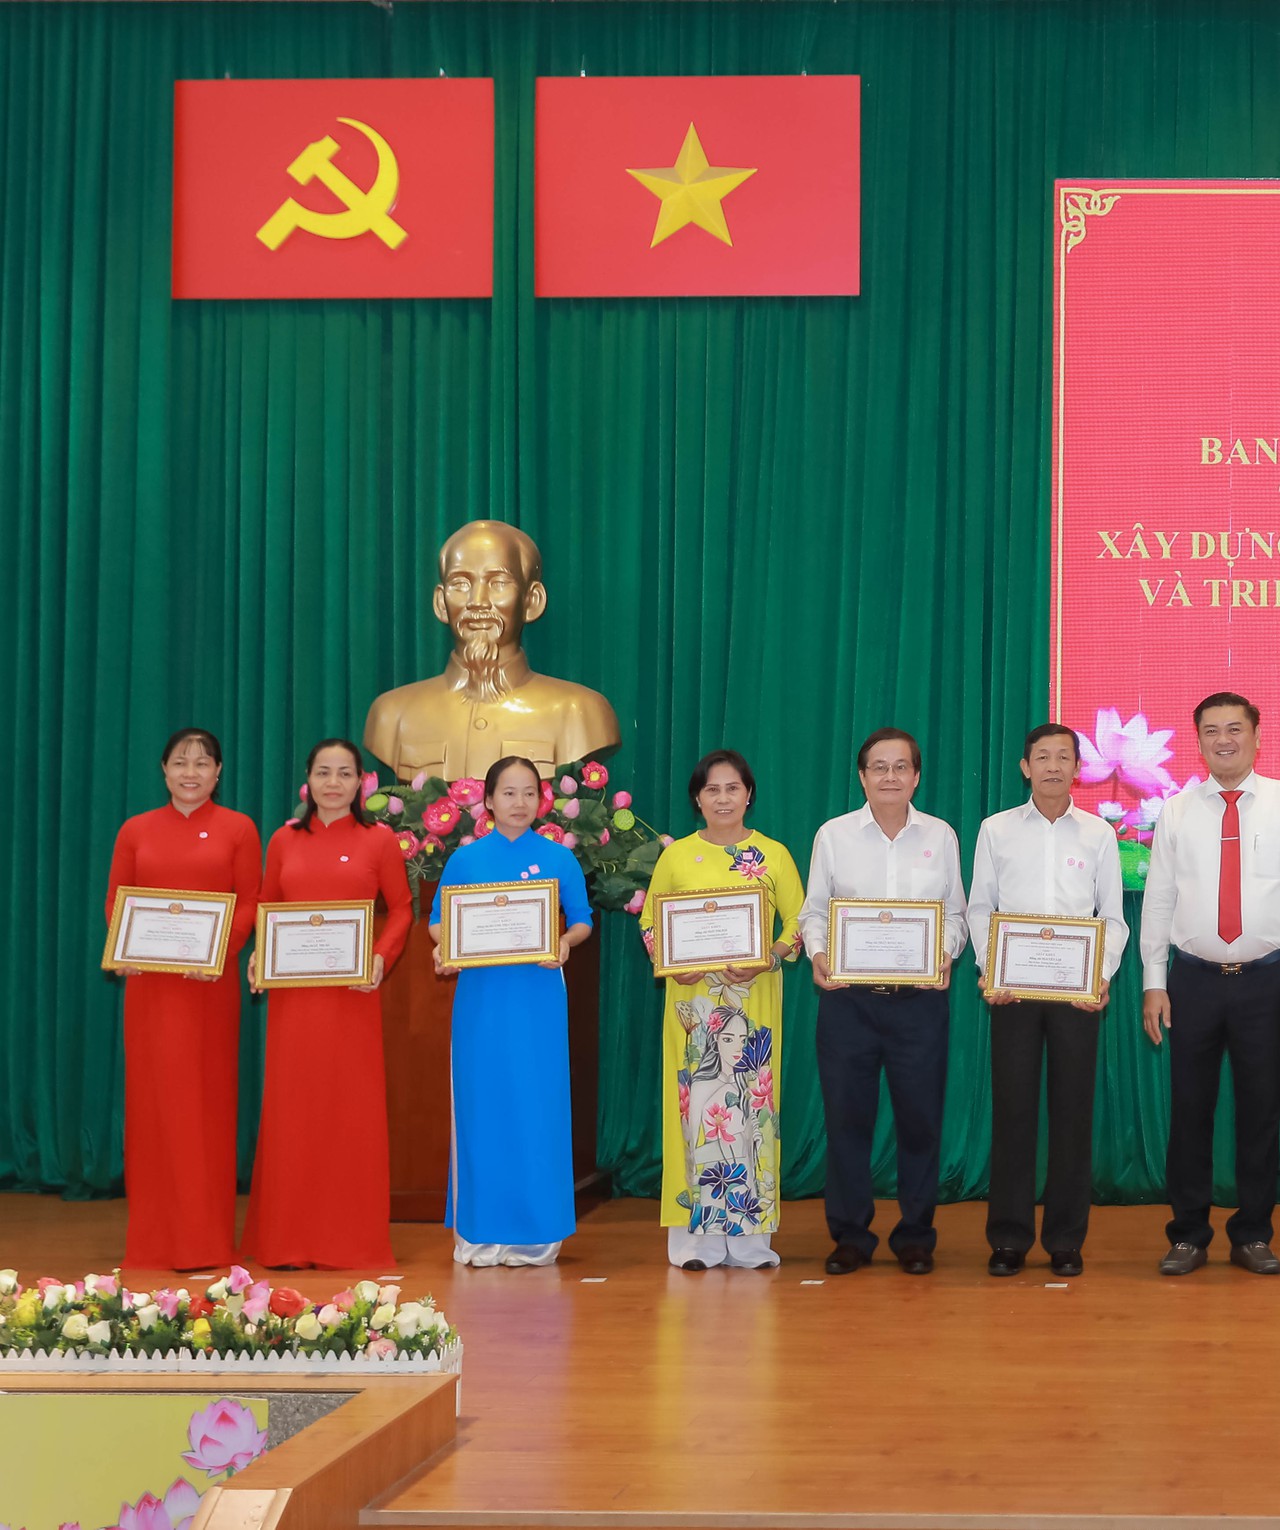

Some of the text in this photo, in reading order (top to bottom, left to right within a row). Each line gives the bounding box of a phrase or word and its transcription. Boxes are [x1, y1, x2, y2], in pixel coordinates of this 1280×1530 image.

[1200, 437, 1279, 465] BAN
[1096, 522, 1180, 560] XÂY
[1138, 571, 1193, 607] VÀ
